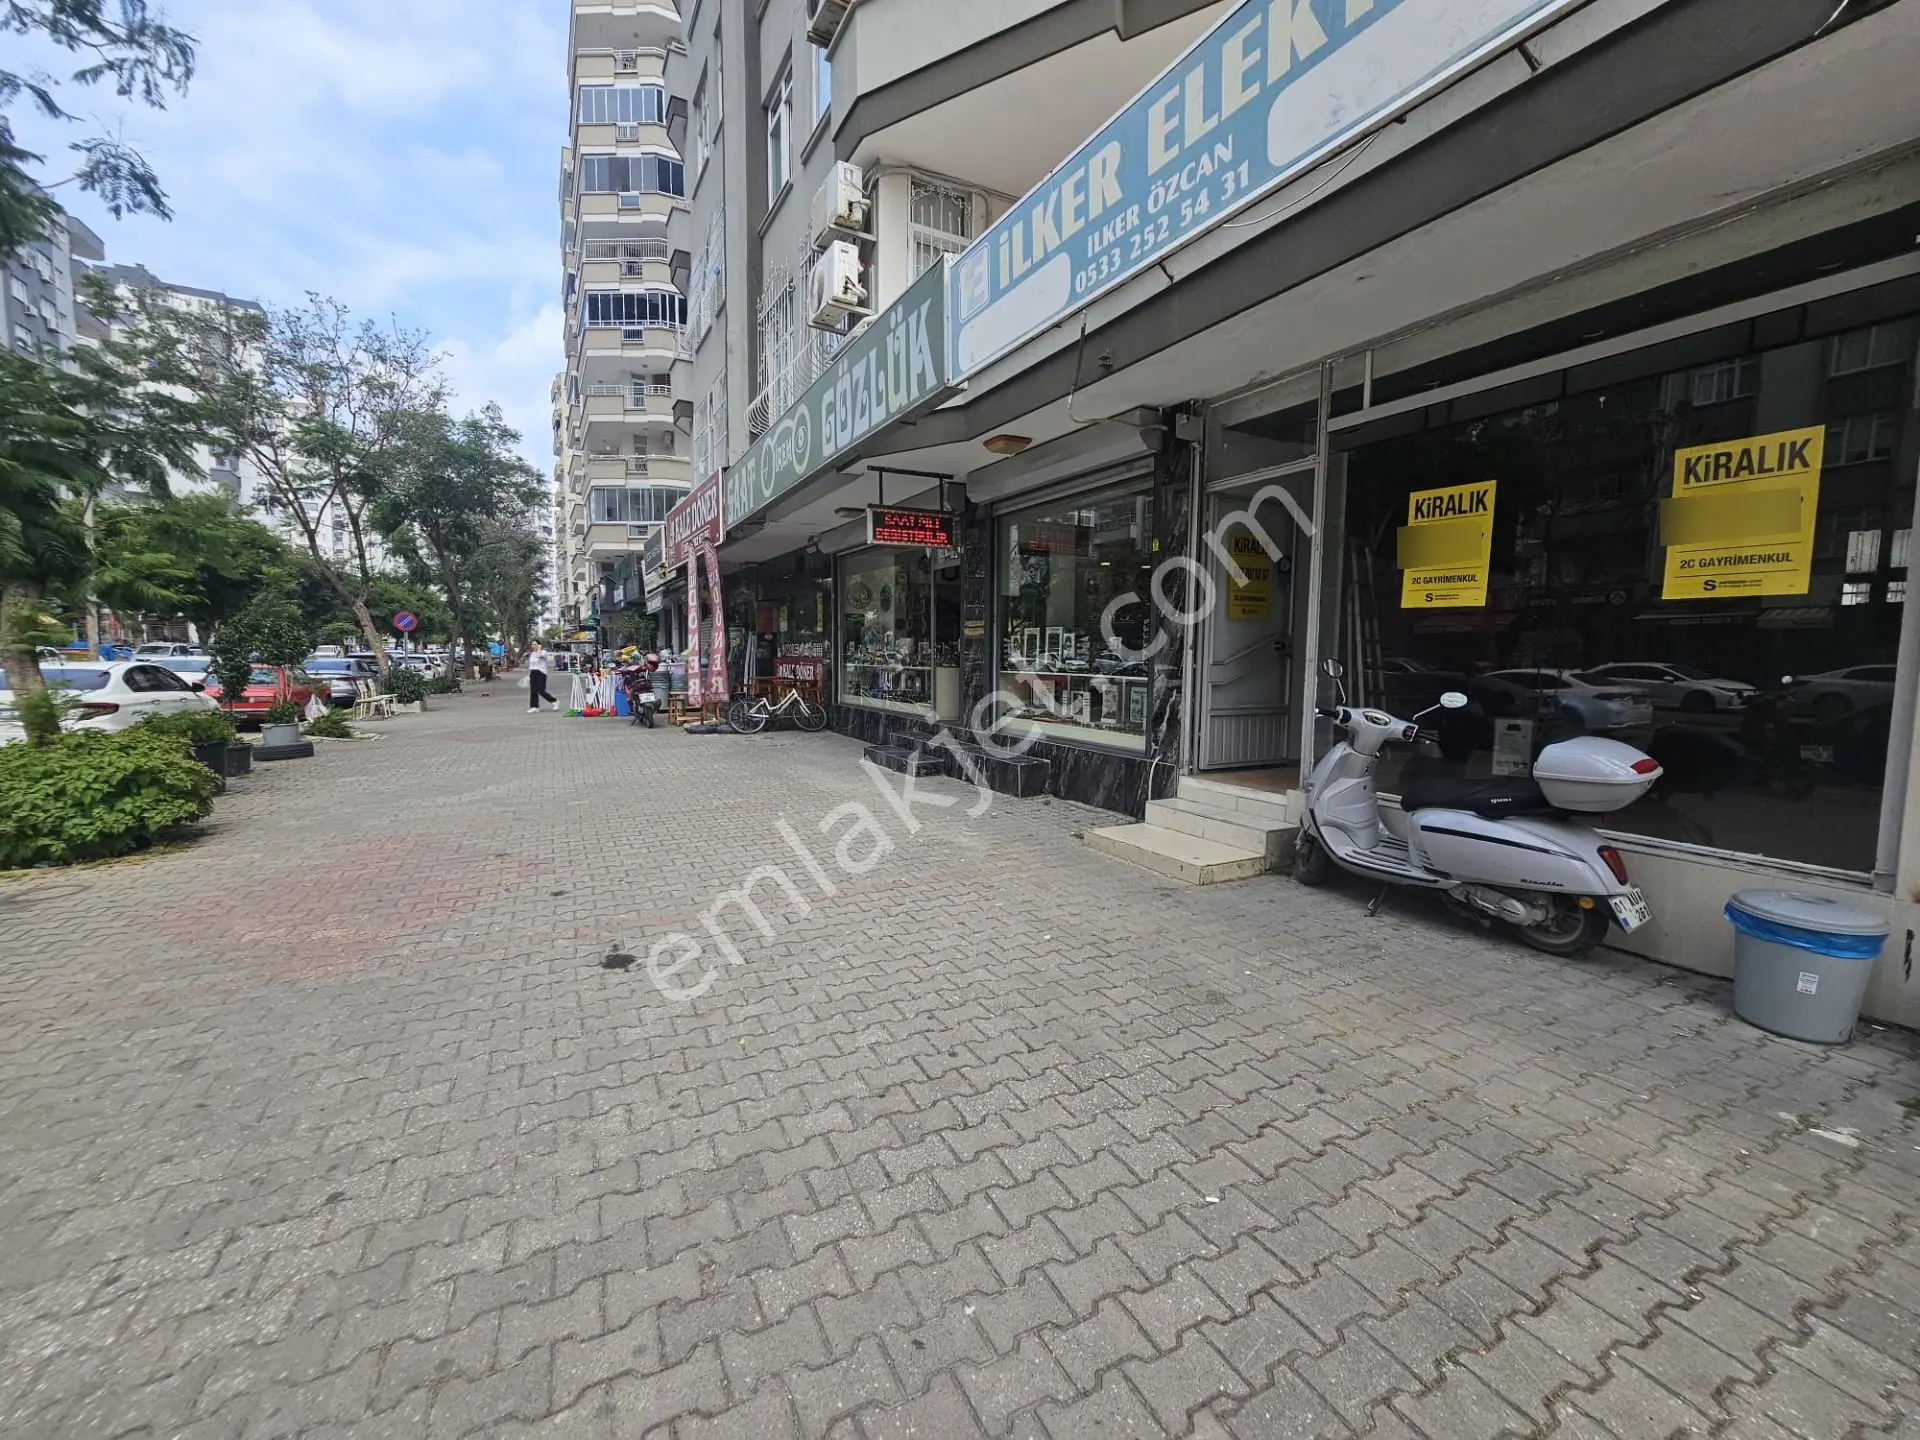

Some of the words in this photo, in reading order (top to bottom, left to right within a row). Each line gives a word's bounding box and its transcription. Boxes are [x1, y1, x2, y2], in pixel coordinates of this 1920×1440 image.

[1000, 141, 1124, 290] İLKER
[1074, 248, 1121, 293] 0533
[1130, 215, 1170, 260] 252
[1180, 187, 1210, 228] 54
[1221, 159, 1250, 201] 31
[1148, 135, 1234, 214] ÖZCAN
[727, 457, 756, 525] SAAT
[821, 298, 938, 457] GÖZLÜK
[1411, 576, 1422, 585] 2C
[1423, 573, 1478, 585] GAYRİMENKUL
[1680, 559, 1695, 569] 2C
[1699, 553, 1793, 568] GAYRİMENKUL
